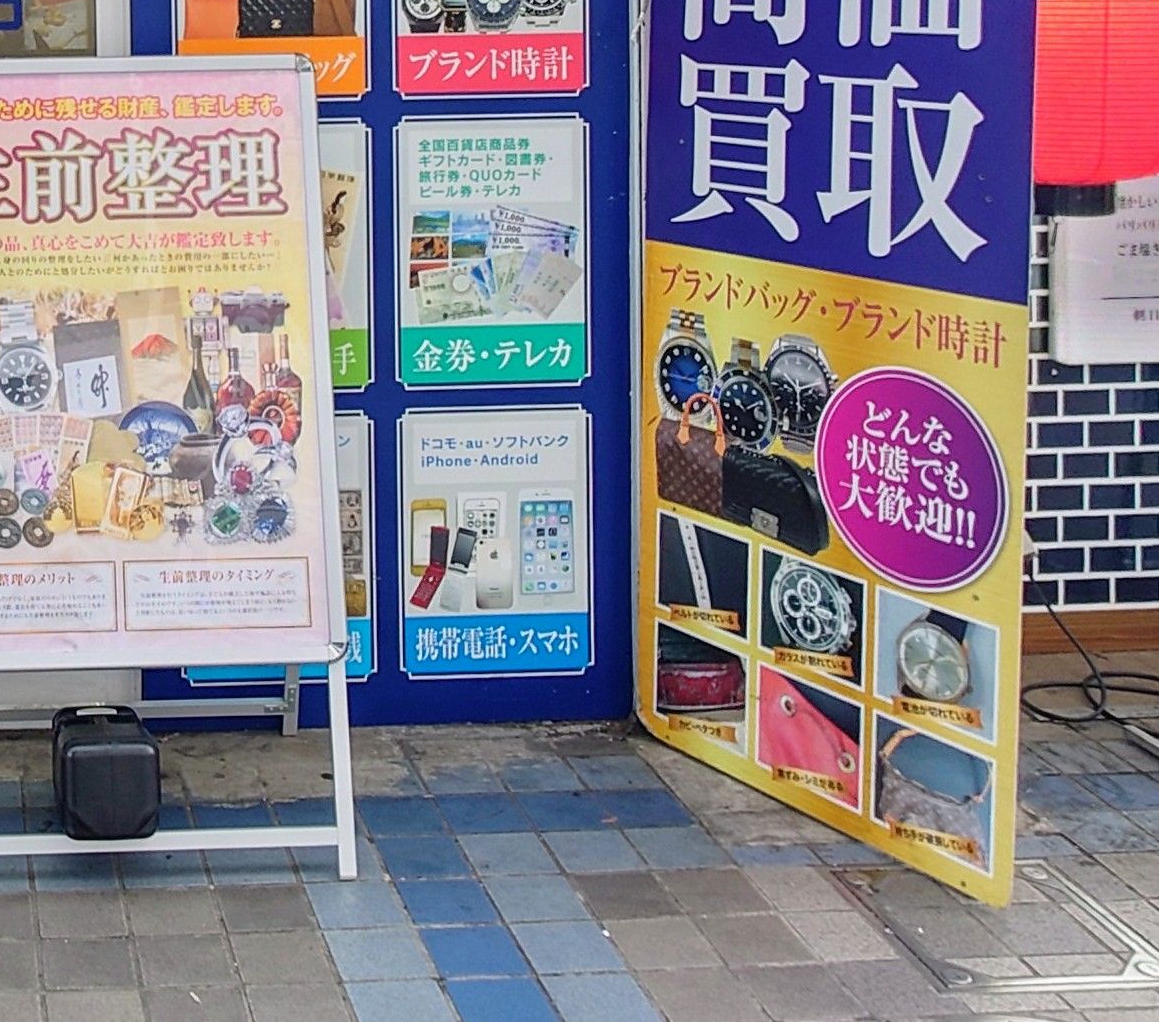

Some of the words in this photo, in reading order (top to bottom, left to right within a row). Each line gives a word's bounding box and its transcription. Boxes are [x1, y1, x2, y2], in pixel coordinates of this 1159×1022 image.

[409, 46, 574, 82] ブランド時計
[418, 138, 530, 153] 全国百貨店商品券
[670, 53, 989, 263] 買取
[660, 264, 1007, 369] ブランドバッグ・ブランド時計
[333, 342, 357, 376] 手
[412, 338, 572, 373] 金券・テレカ
[421, 435, 569, 450] ドコモ・au・ソフトバンク
[861, 400, 953, 455] どんな
[846, 434, 969, 500] 状態でも
[838, 476, 977, 550] 大歓迎!!
[159, 569, 275, 585] 生前整理のタイミング
[416, 626, 578, 661] 携帯電話・スマホ
